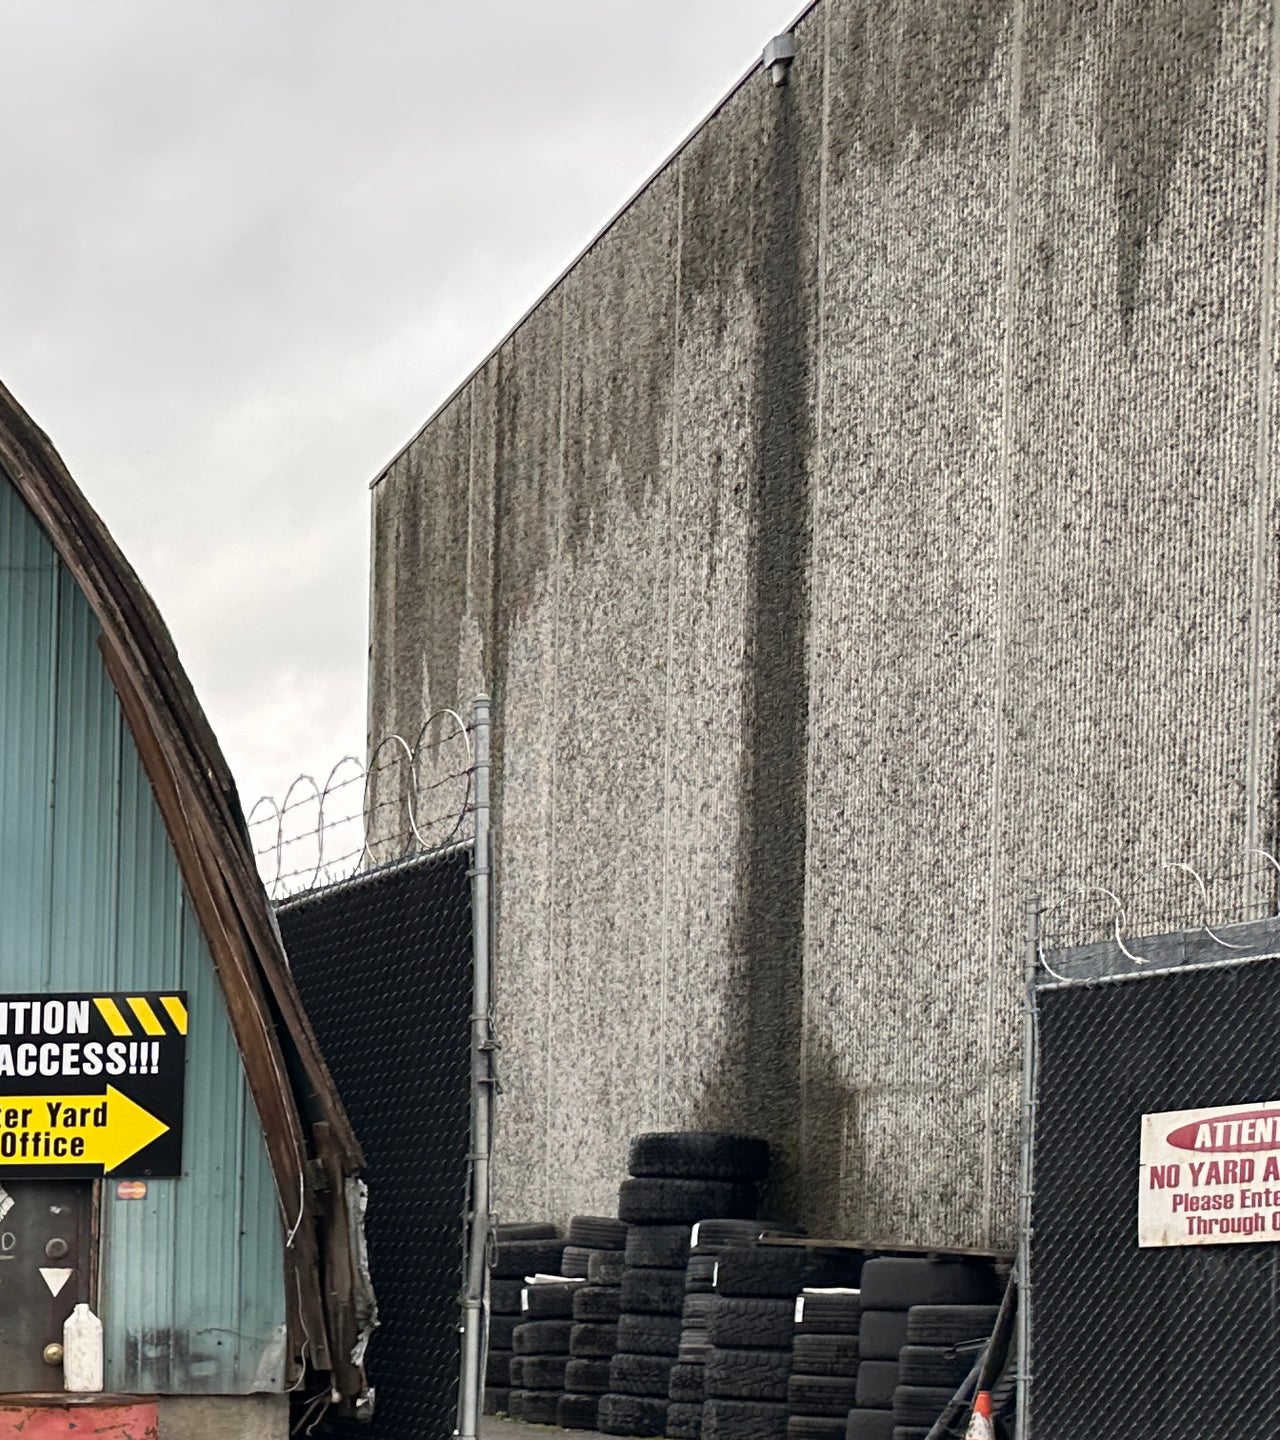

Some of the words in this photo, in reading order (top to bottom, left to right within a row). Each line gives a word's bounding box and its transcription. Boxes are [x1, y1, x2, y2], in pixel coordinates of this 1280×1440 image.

[46, 1101, 108, 1128] Yard
[0, 1132, 85, 1158] Office
[1149, 1164, 1181, 1190] NO
[1188, 1158, 1255, 1187] YARD
[1172, 1193, 1234, 1213] Please
[1186, 1212, 1266, 1236] Through
